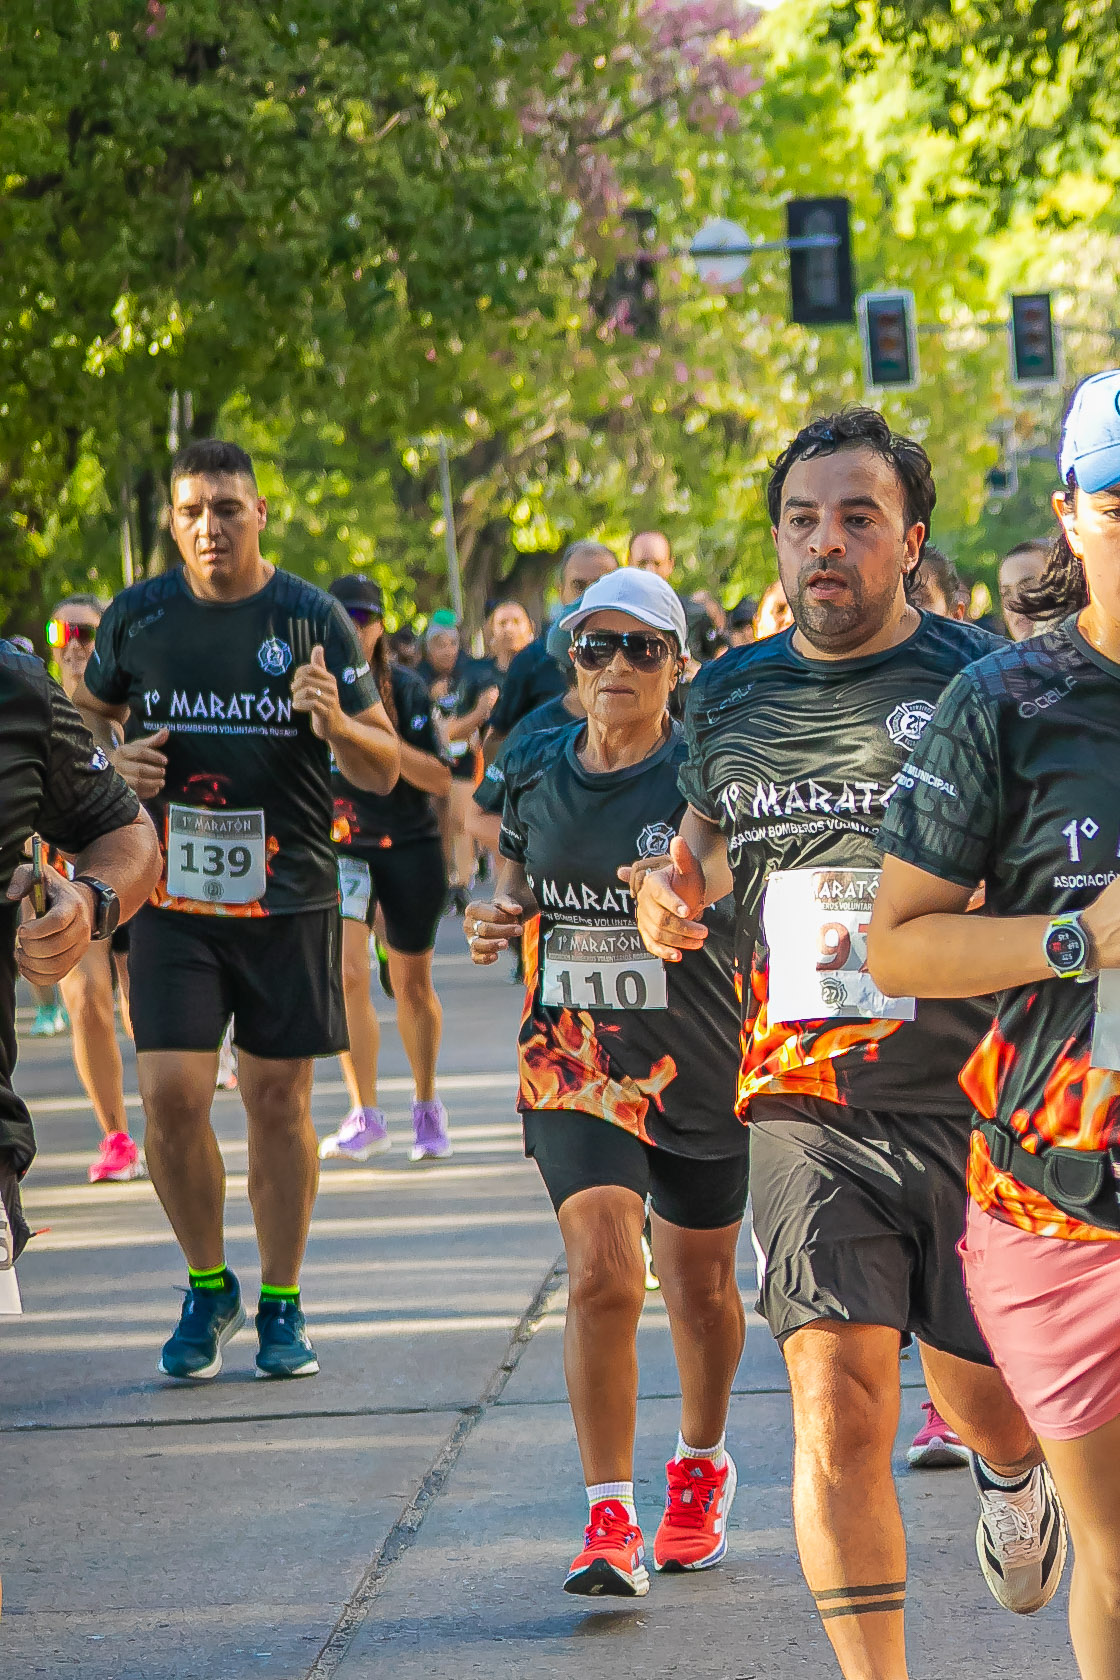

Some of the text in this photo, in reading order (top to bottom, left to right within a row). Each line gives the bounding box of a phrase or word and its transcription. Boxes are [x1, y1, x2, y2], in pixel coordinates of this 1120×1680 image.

[170, 687, 292, 723] MARATÓN
[768, 820, 825, 838] BOMBEROS
[180, 842, 252, 878] 139
[542, 878, 631, 914] MARAT
[839, 901, 872, 911] VOLUNTAR
[570, 932, 641, 953] MARATÓN
[556, 969, 647, 1010] 110
